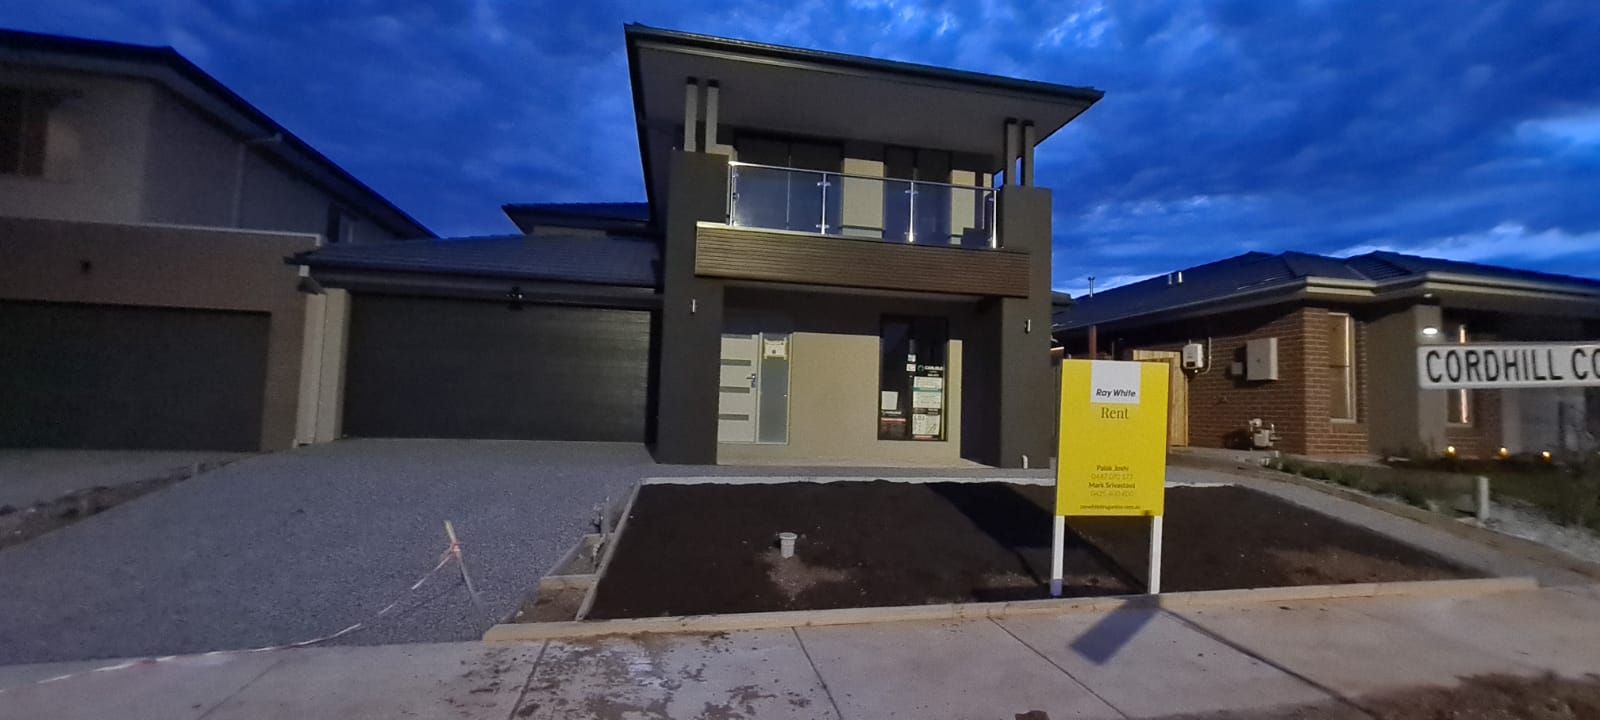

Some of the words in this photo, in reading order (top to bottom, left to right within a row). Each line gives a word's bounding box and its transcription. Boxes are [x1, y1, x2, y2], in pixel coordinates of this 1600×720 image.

[1426, 350, 1563, 383] CORDHILL
[1095, 388, 1112, 398] Ray
[1113, 389, 1136, 397] White
[1101, 407, 1129, 419] Rent
